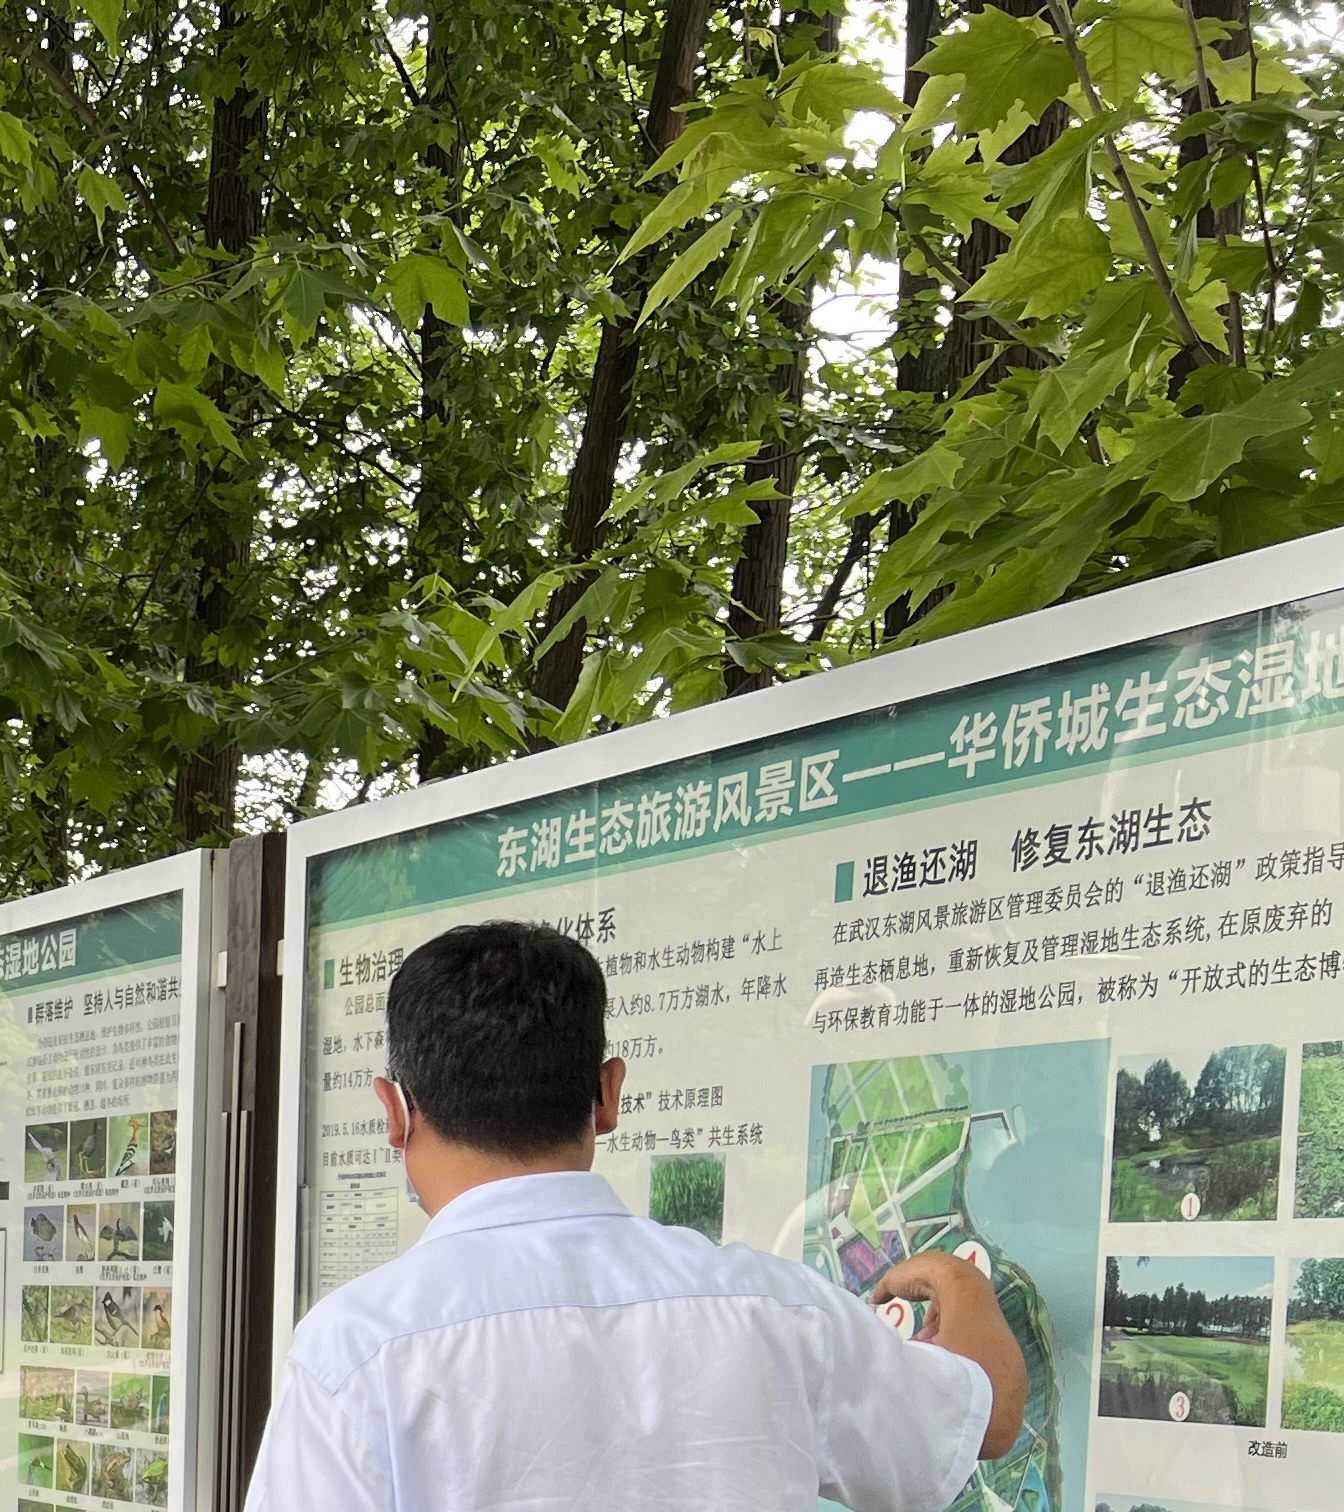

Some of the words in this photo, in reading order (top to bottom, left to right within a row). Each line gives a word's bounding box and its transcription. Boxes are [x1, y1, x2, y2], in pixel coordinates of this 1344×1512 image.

[863, 839, 978, 898] 退渔还湖
[1011, 796, 1213, 873] 修复东湖生态
[83, 975, 182, 1016] 坚持人与自然和谐共
[811, 949, 1344, 1034] 与环保教育功能于一体的湿地公园，被称为“开放式的生态博
[1175, 1395, 1186, 1418] 3
[1247, 1439, 1288, 1459] 改造前
